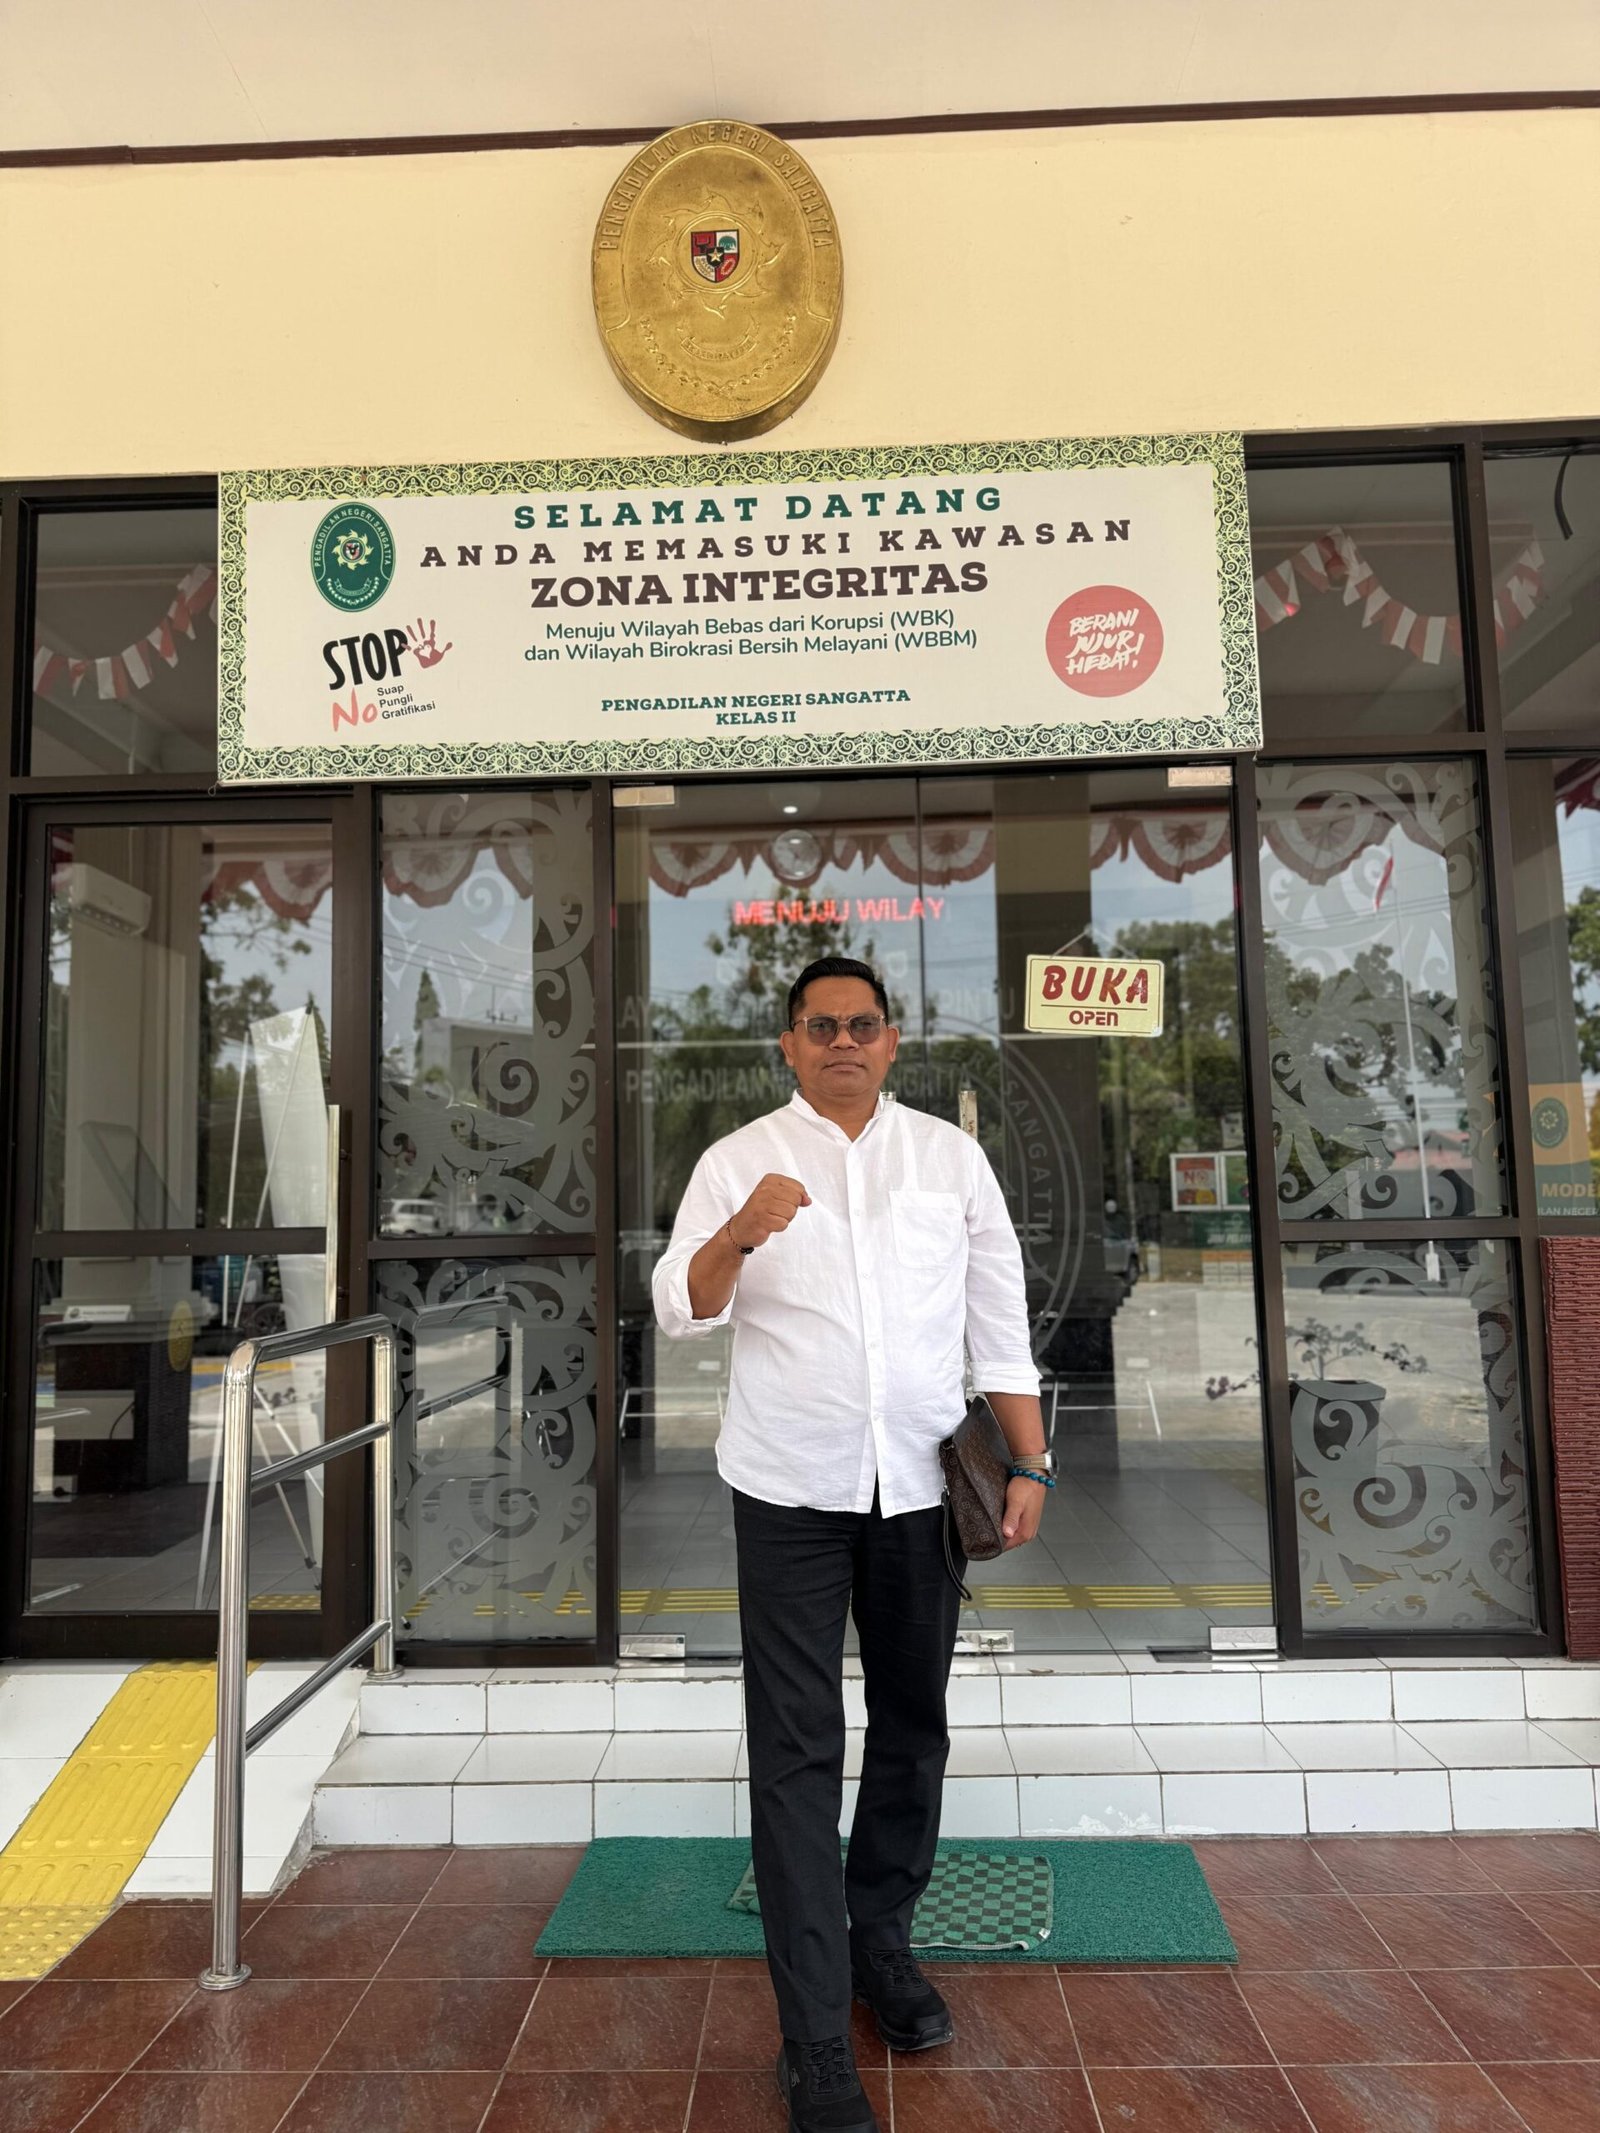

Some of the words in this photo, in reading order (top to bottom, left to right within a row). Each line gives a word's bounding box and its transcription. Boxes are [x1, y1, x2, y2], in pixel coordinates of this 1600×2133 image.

[600, 136, 682, 251] PENGADILAN
[691, 122, 771, 154] NEGERI
[774, 152, 834, 249] SANGATTA
[514, 497, 758, 530] SELAMAT
[785, 487, 1001, 520] DATANG
[314, 514, 341, 568] PENGADILAN
[341, 508, 374, 522] NEGERI
[373, 520, 392, 566] SANGATTA
[420, 543, 556, 567] ANDA
[583, 532, 852, 563] MEMASUKI
[879, 519, 1131, 553] KAWASAN
[531, 574, 673, 609] ZONA
[682, 561, 989, 605] INTEGRITAS
[546, 622, 616, 642] Menuju
[621, 619, 700, 640] Wilayah
[705, 617, 764, 635] Bebas
[768, 615, 805, 632] dari
[810, 612, 884, 633] Korupsi
[890, 609, 955, 631] (WBK)
[1069, 607, 1140, 638] BERANI
[322, 628, 408, 691] STOP
[524, 645, 560, 661] dan
[565, 642, 644, 662] Wilayah
[649, 639, 733, 658] Birokrasi
[738, 637, 799, 655] Bersih
[804, 634, 888, 654] Melayani
[894, 629, 978, 652] (WBBM)
[376, 684, 405, 697] Suap
[379, 693, 414, 709] Pungli
[601, 696, 727, 712] PENGADILAN
[731, 693, 802, 708] NEGERI
[805, 689, 911, 706] SANGATTA
[332, 686, 378, 732] No
[381, 700, 436, 720] Gratifikasi
[716, 711, 778, 726] KELAS
[782, 710, 797, 724] II
[733, 899, 850, 926] MENUJU
[857, 897, 946, 922] WILAY
[1042, 964, 1149, 1005] BUKA
[1068, 1009, 1119, 1028] OPEN
[1541, 1183, 1600, 1198] MODE
